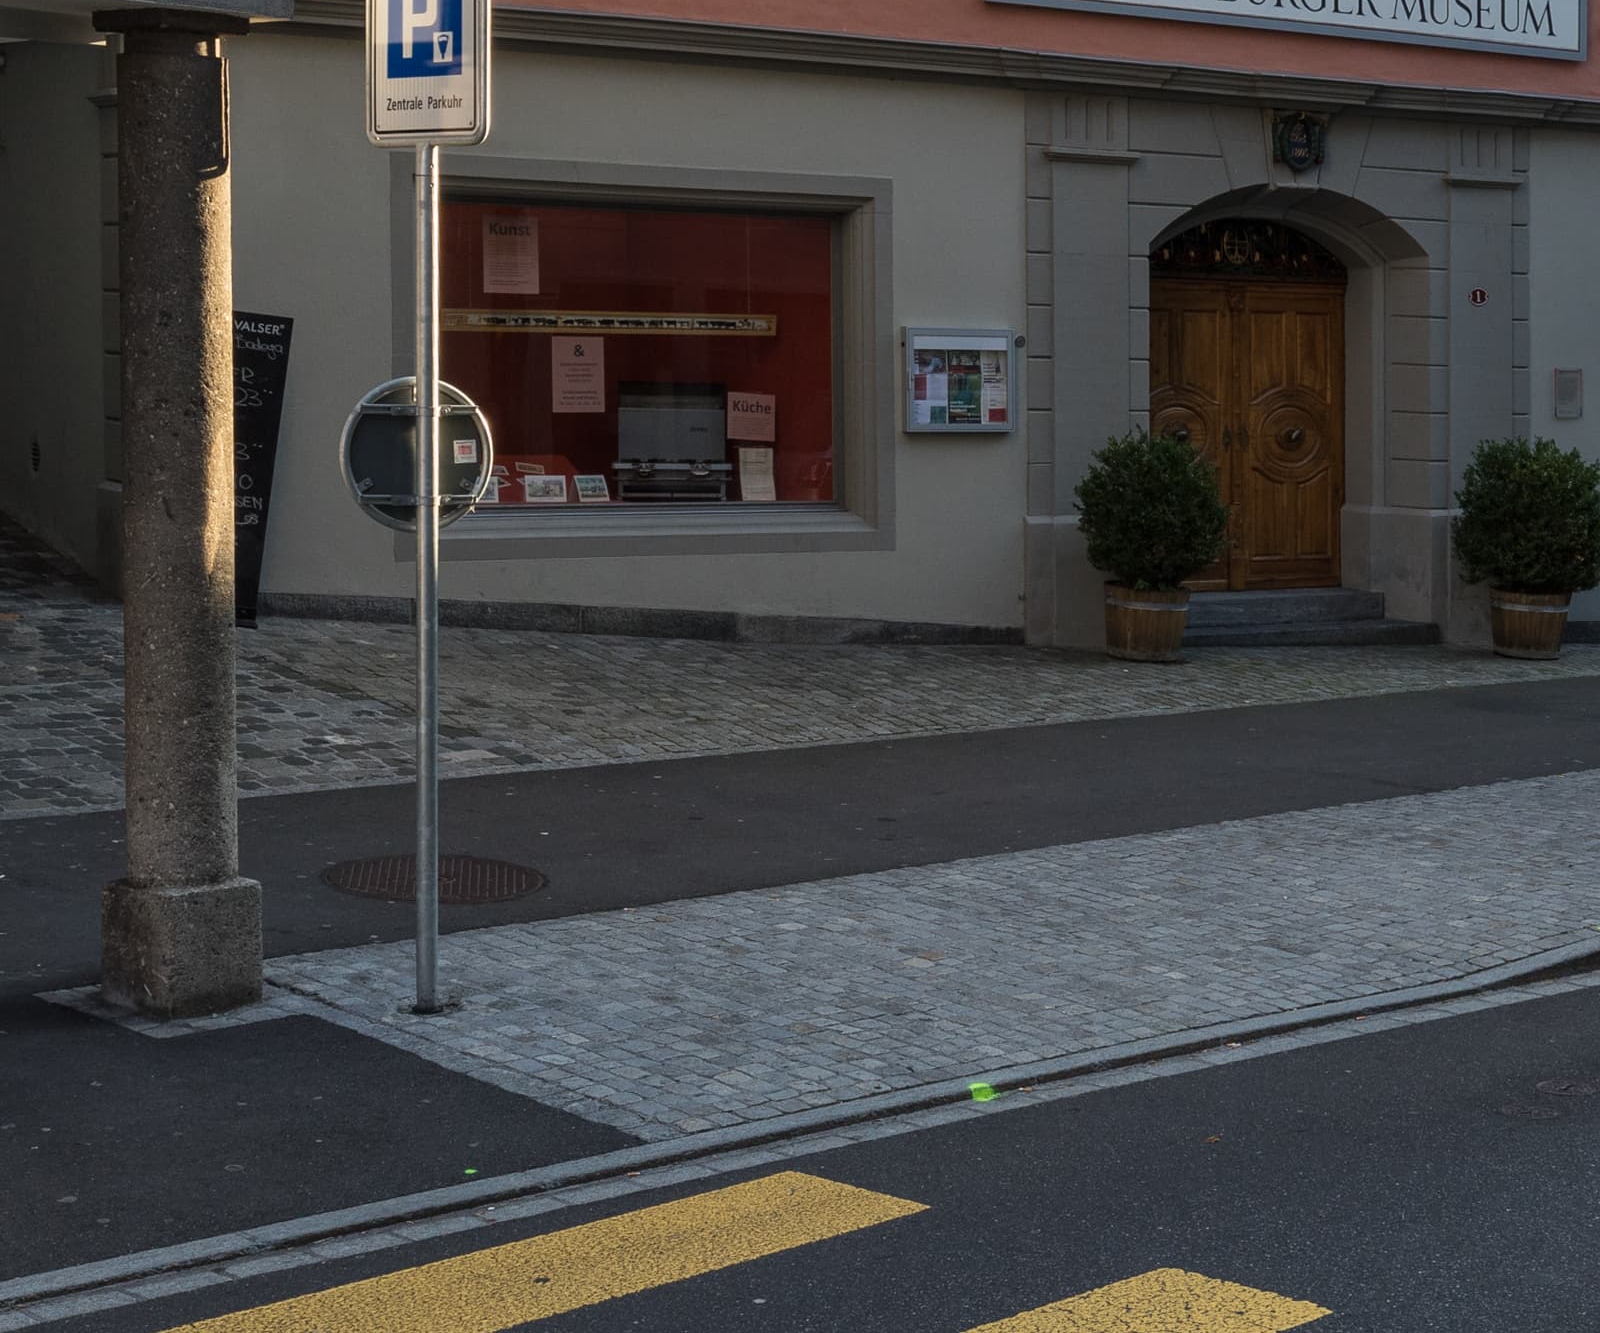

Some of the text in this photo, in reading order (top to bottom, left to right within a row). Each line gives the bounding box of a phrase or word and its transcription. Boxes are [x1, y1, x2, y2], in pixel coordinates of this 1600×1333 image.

[386, 94, 463, 111] Zentrale Parkuhr
[489, 221, 531, 237] Kunst
[574, 344, 585, 358] &
[733, 399, 772, 415] Küche
